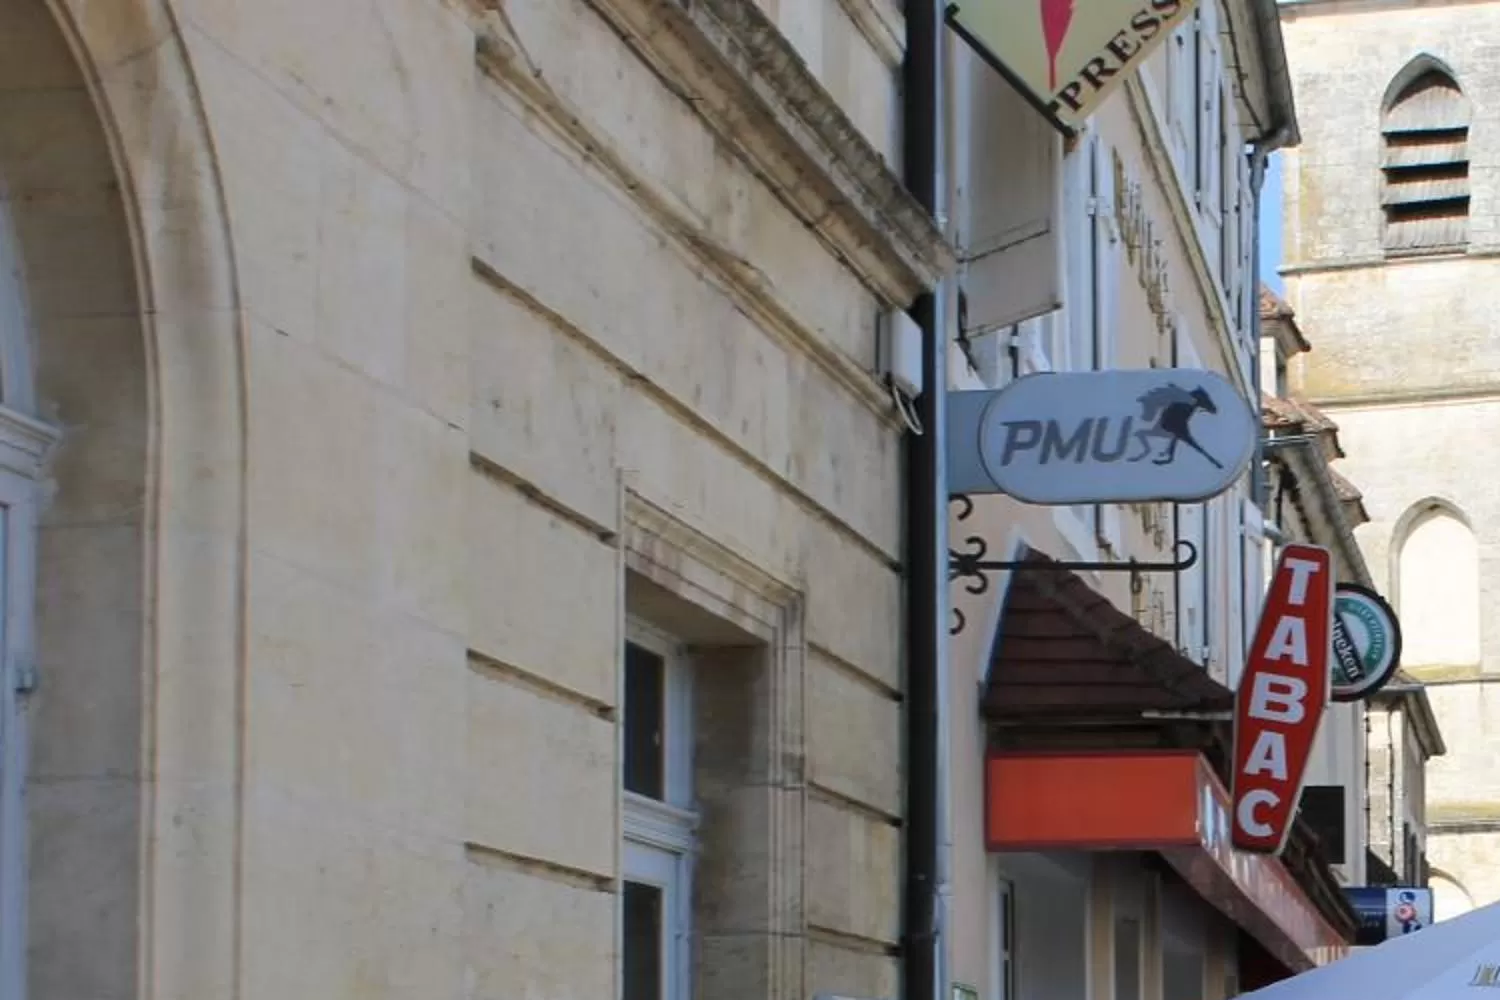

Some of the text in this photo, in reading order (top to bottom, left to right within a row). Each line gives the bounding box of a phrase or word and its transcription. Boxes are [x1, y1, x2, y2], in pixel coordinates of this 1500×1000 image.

[1000, 416, 1134, 467] PMU
[1331, 612, 1360, 680] ineken
[1236, 557, 1321, 839] TABAC
